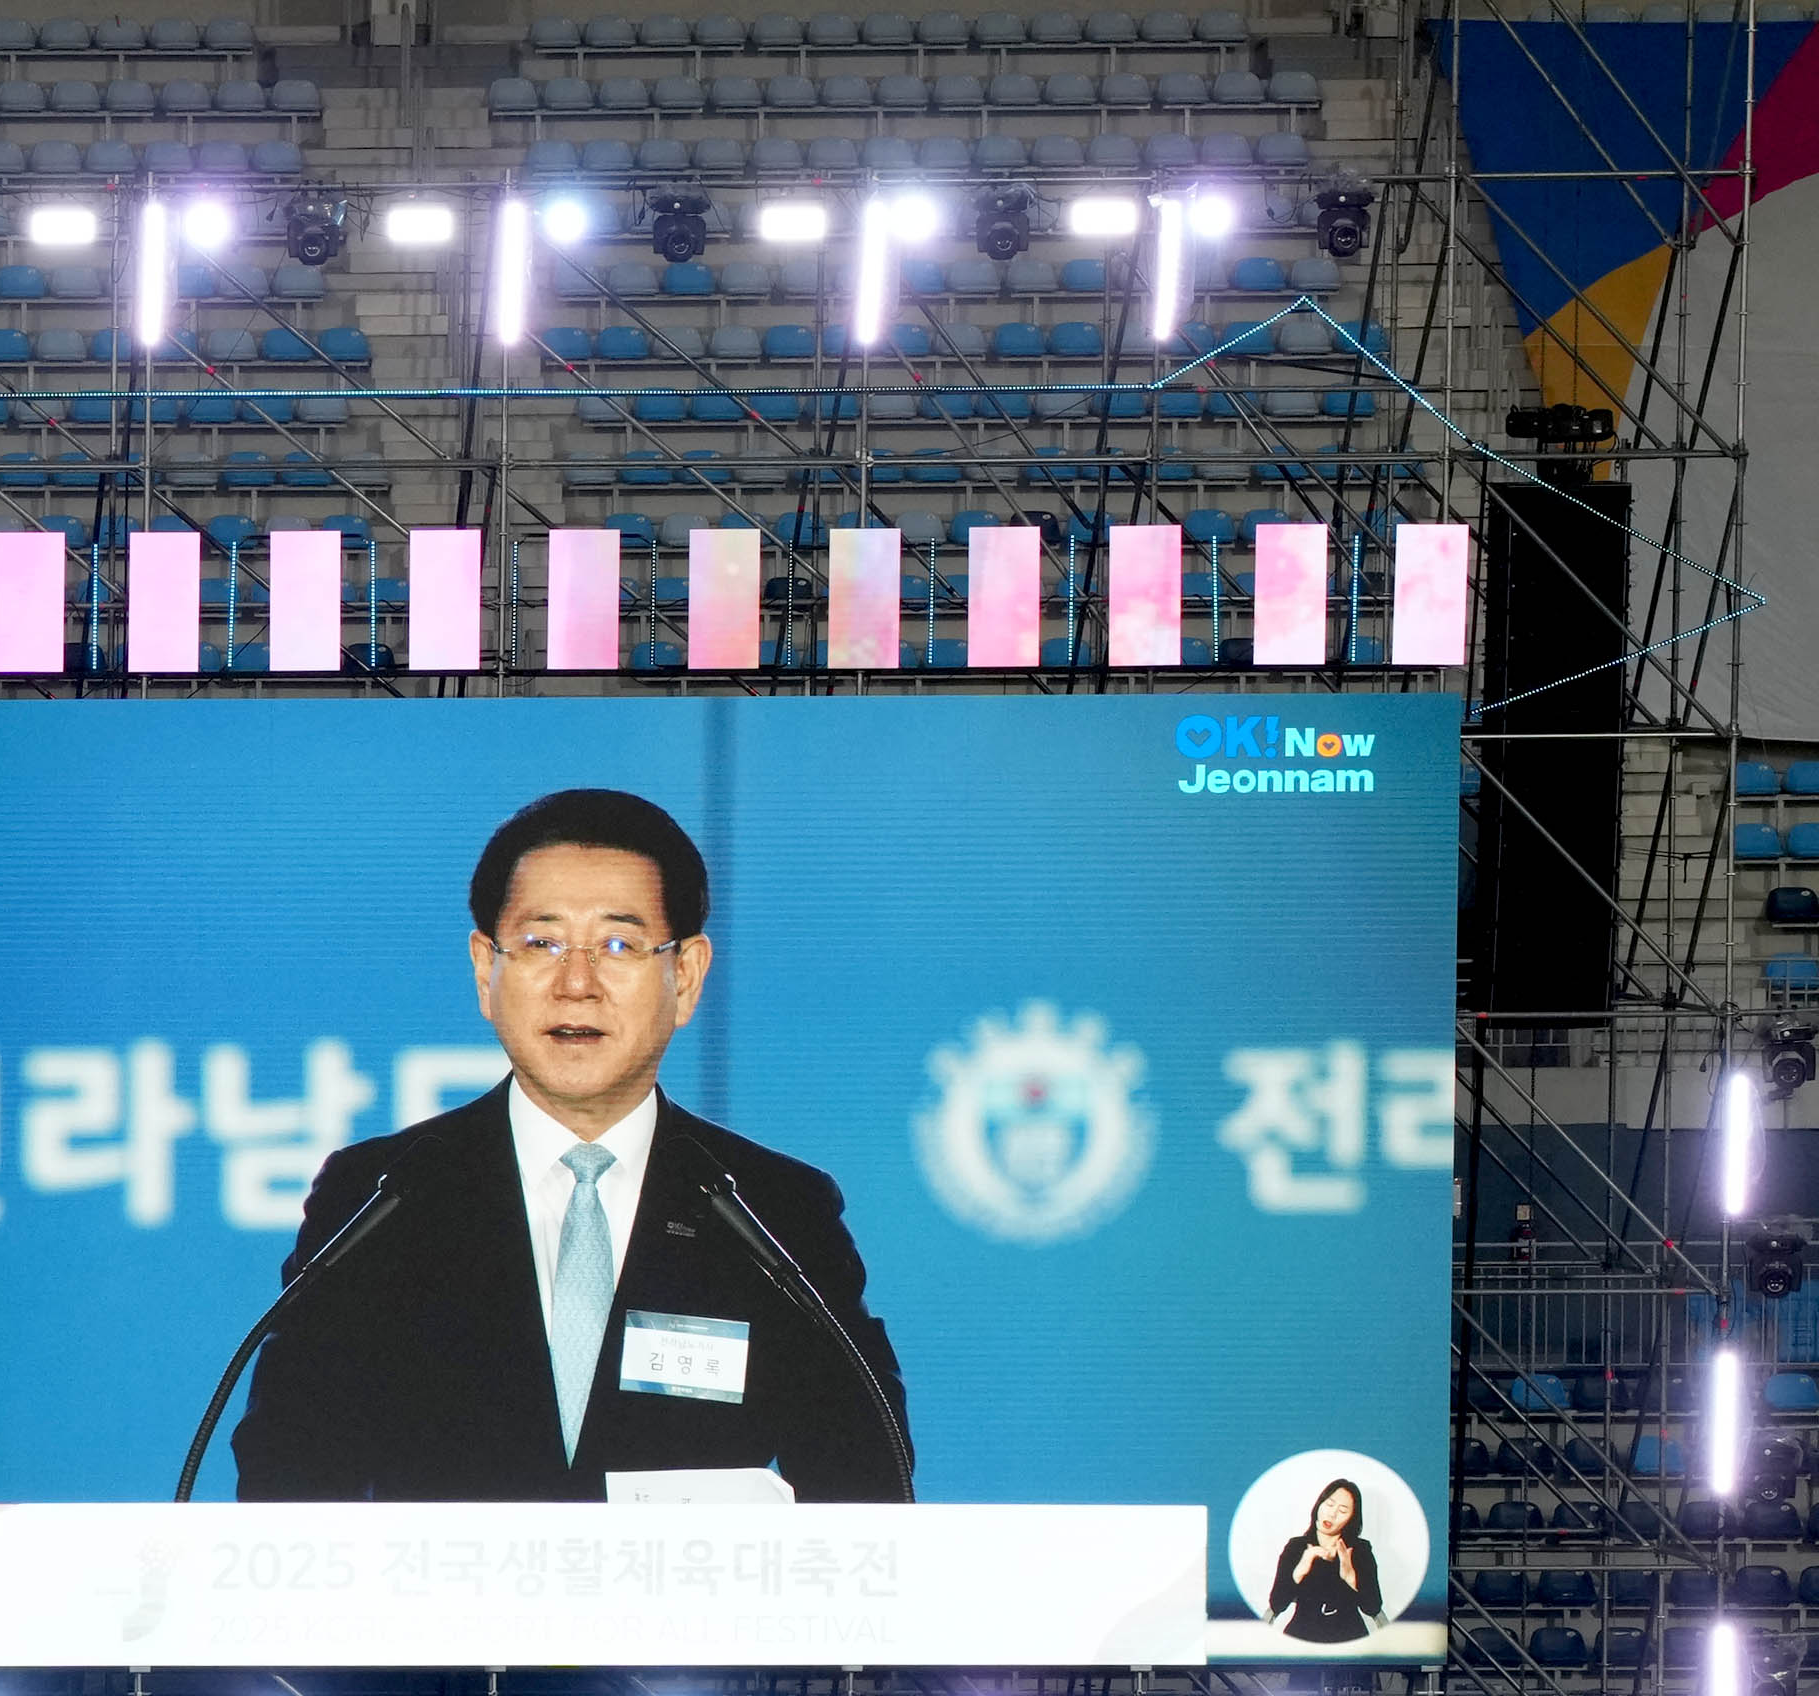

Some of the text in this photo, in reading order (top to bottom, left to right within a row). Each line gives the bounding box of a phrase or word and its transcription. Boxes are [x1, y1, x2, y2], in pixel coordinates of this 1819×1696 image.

[1175, 714, 1280, 760] OK!
[1178, 763, 1374, 794] Jeonnam
[211, 1537, 900, 1599] 2025 전국생활체육대축전
